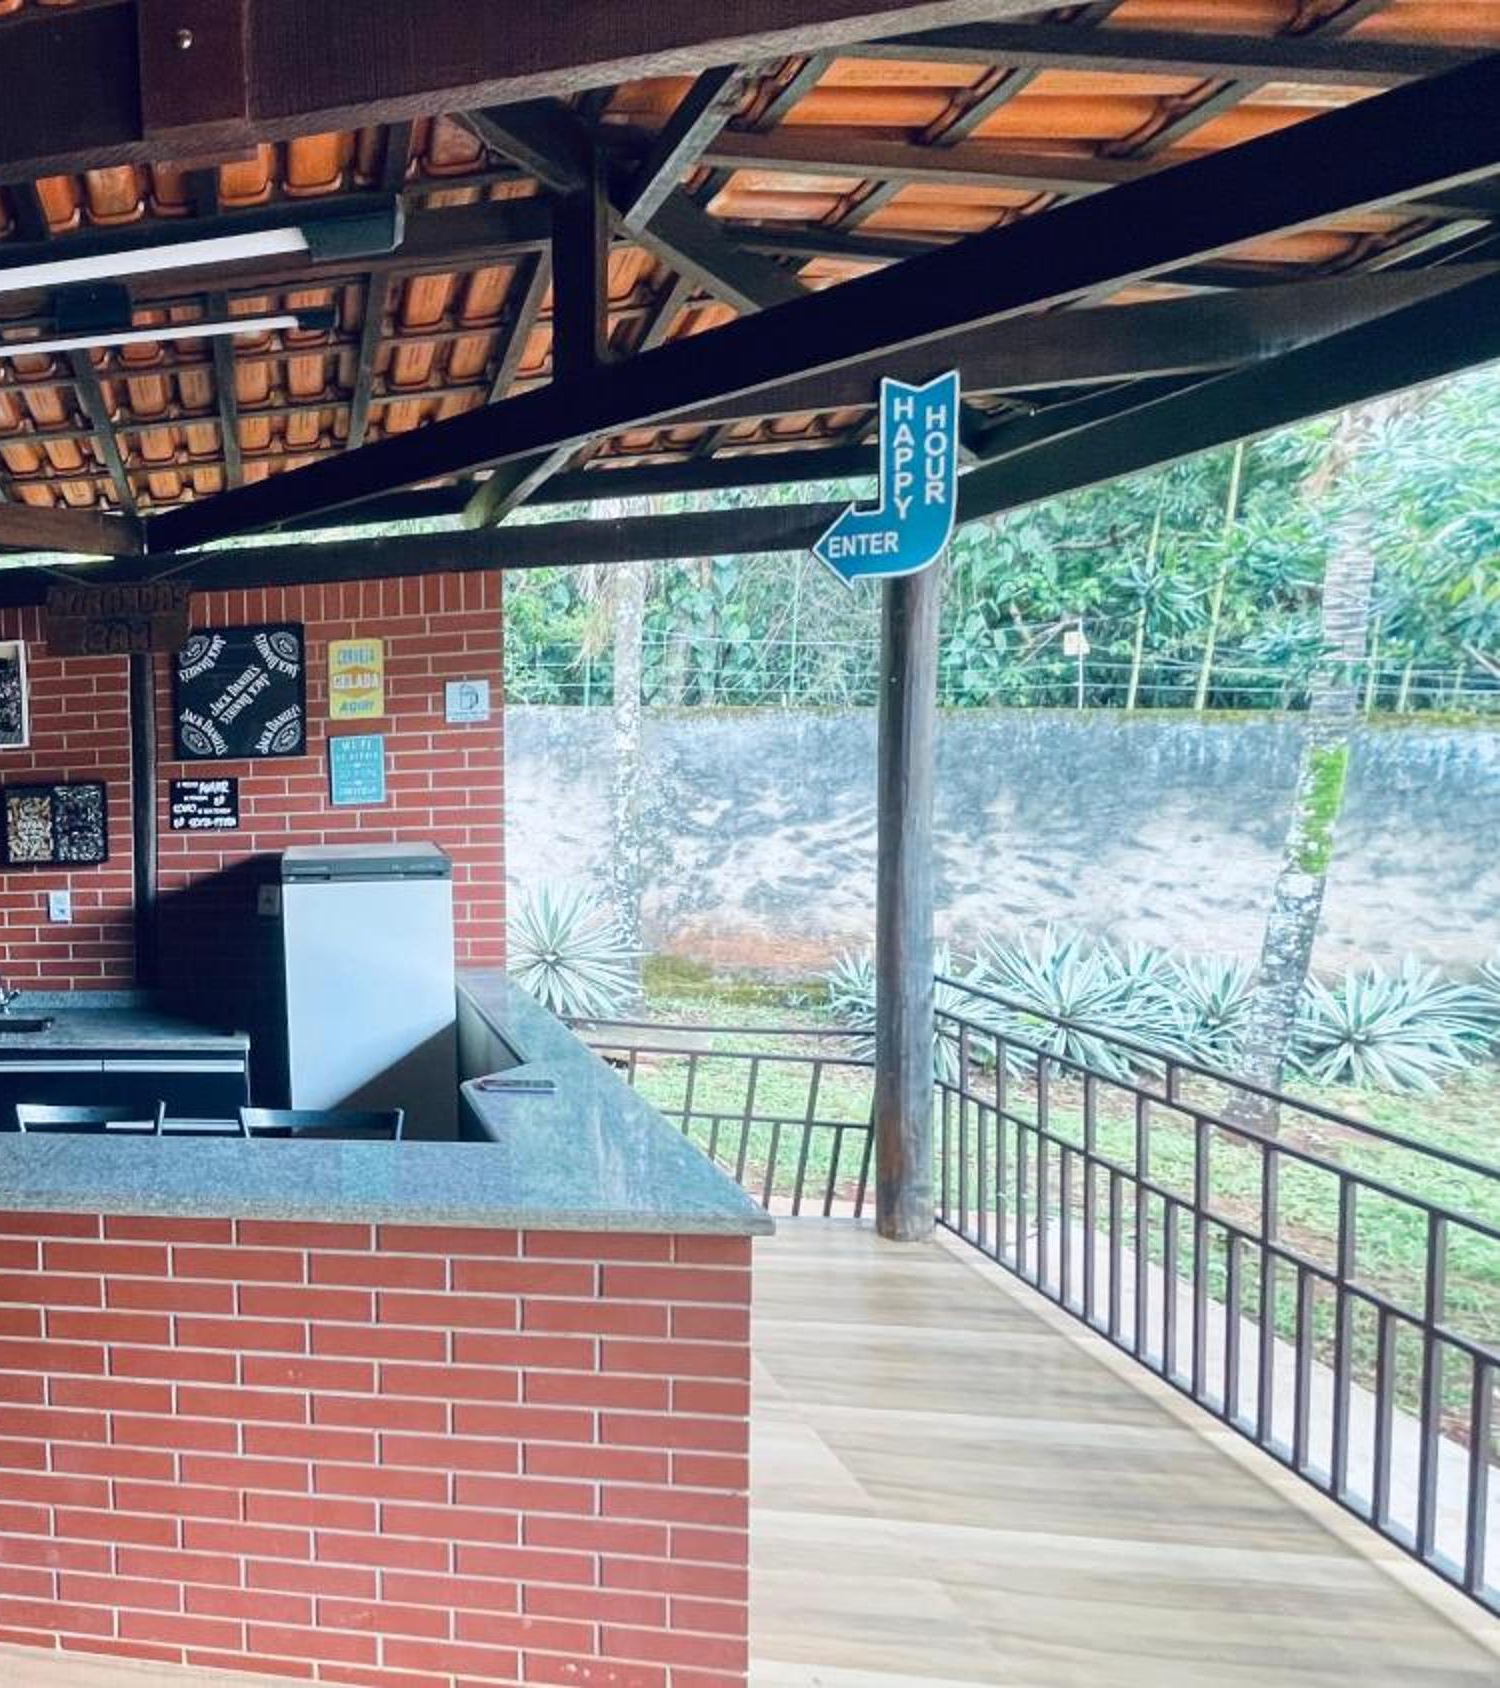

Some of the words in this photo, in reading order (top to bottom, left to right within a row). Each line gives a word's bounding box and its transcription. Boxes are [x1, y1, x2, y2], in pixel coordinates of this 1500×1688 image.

[893, 396, 915, 519] HAPPY
[924, 405, 948, 505] HOUR
[827, 531, 900, 559] ENTER
